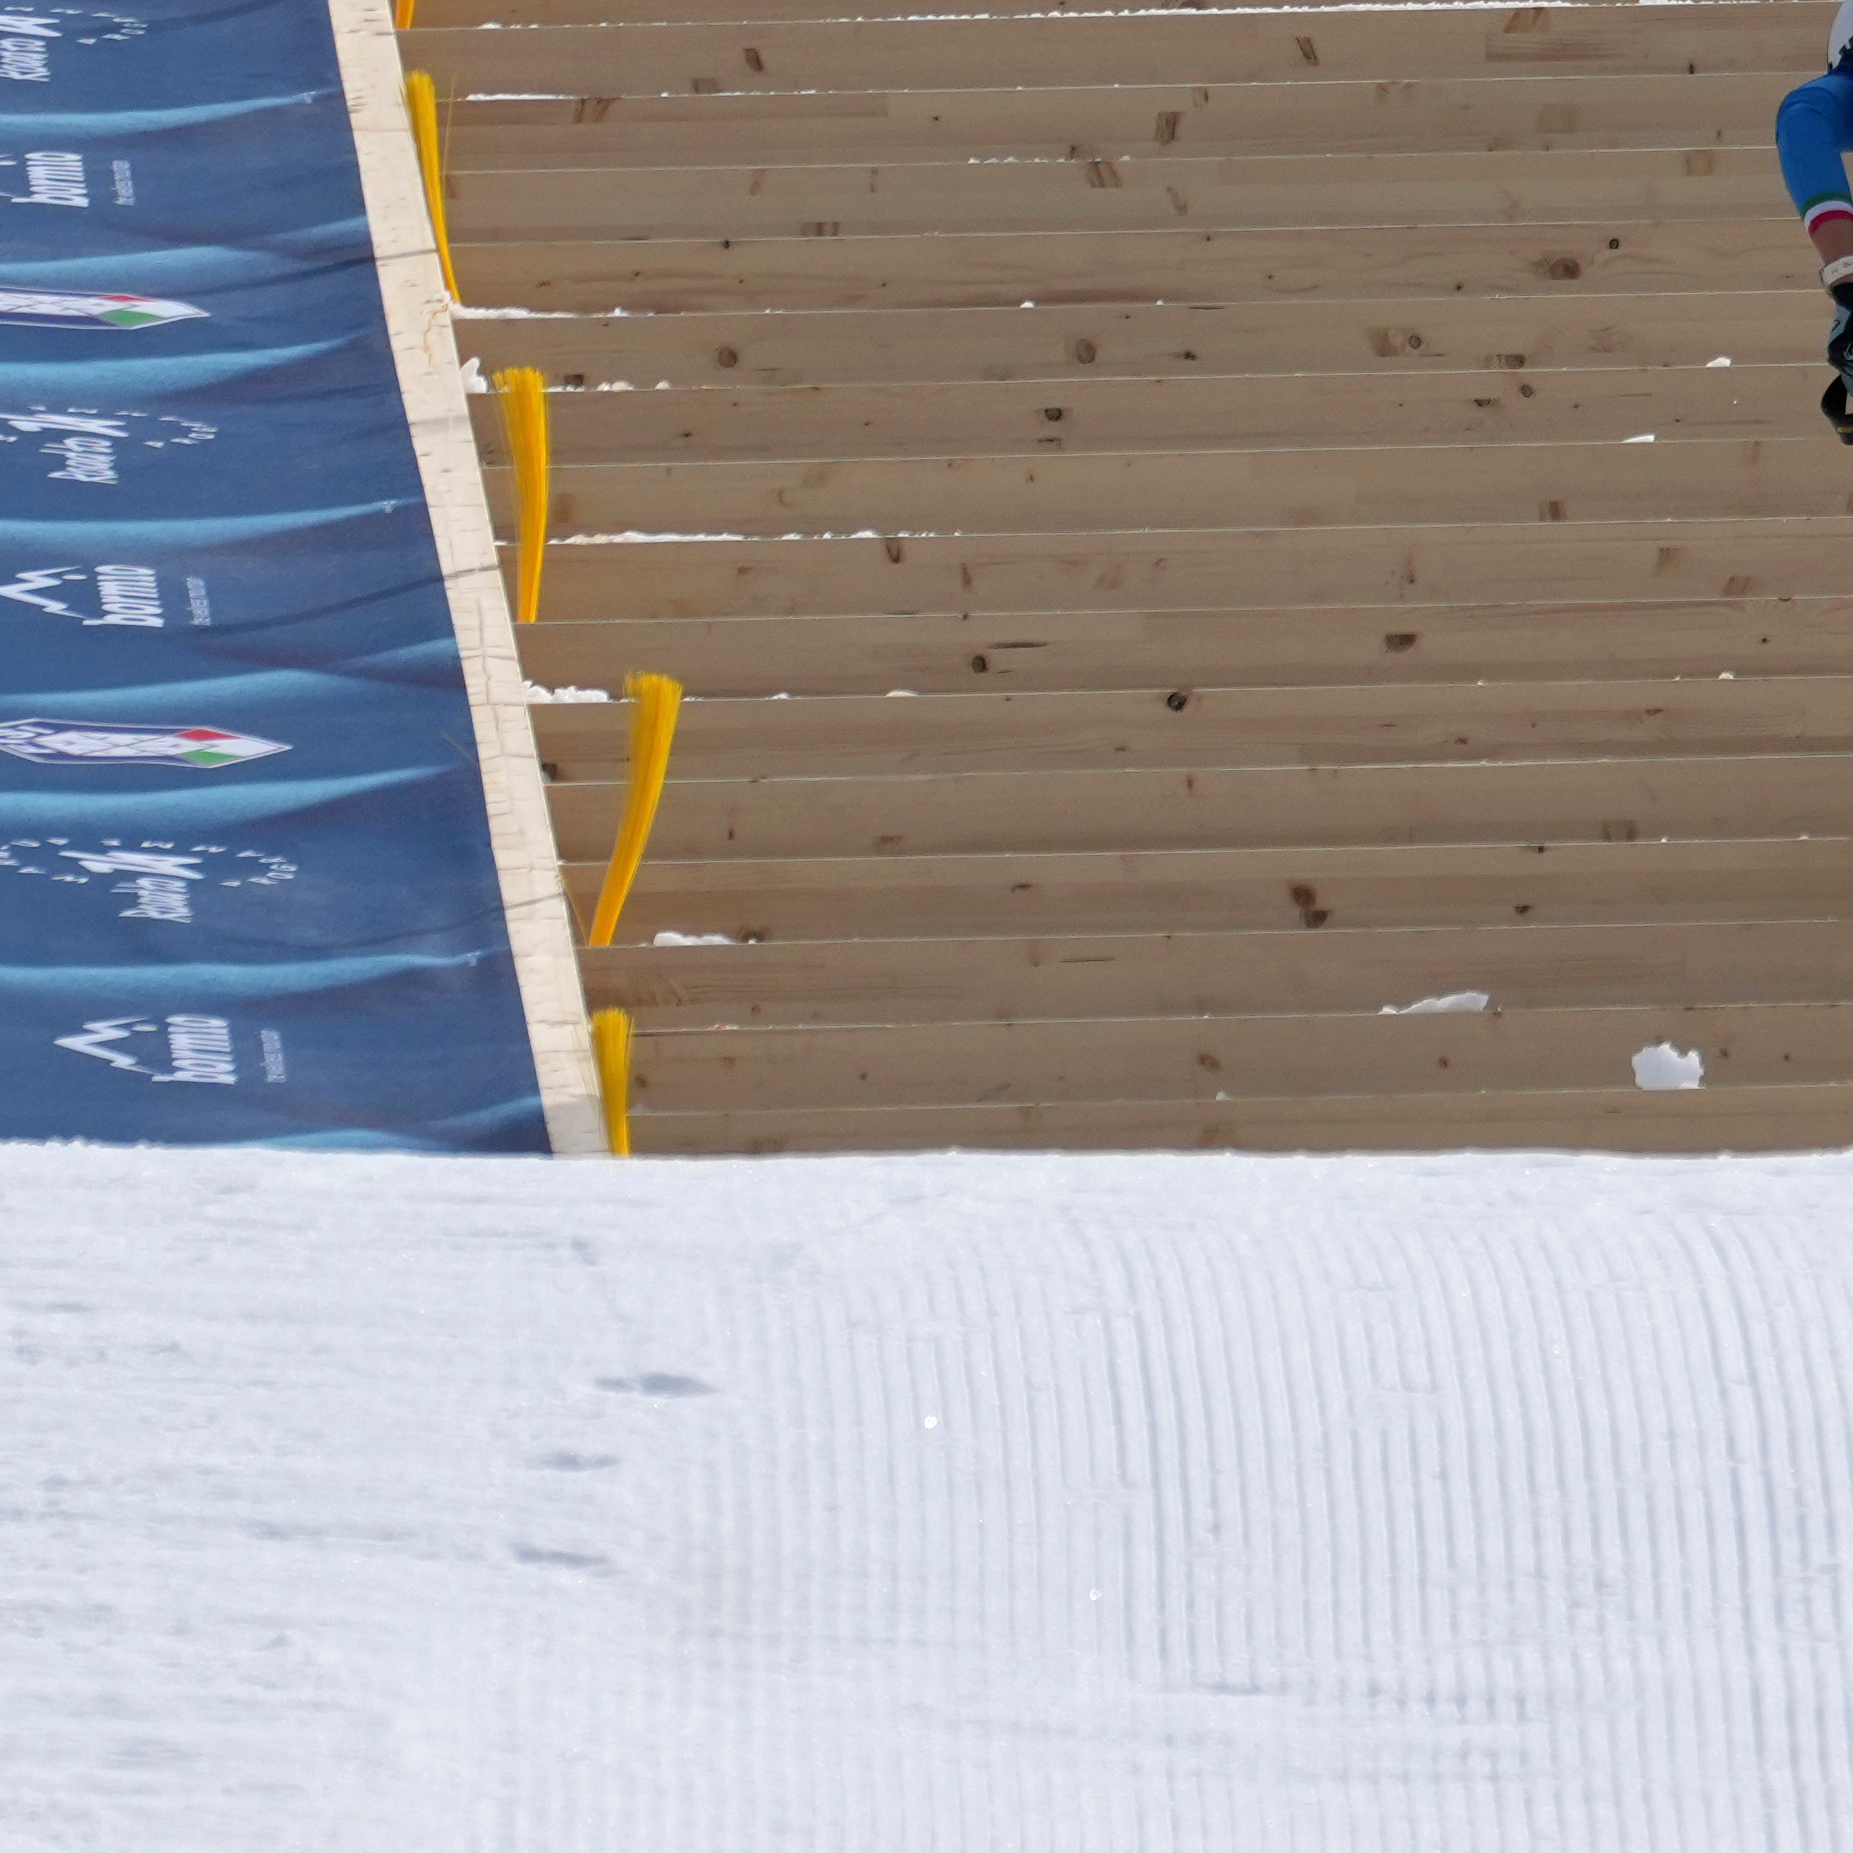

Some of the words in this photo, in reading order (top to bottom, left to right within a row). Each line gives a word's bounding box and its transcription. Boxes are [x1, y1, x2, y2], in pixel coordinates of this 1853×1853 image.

[11, 151, 90, 208] bormio
[38, 449, 119, 485] Road
[82, 564, 164, 628] bormio
[110, 889, 193, 923] Road
[152, 1014, 237, 1085] bormio
